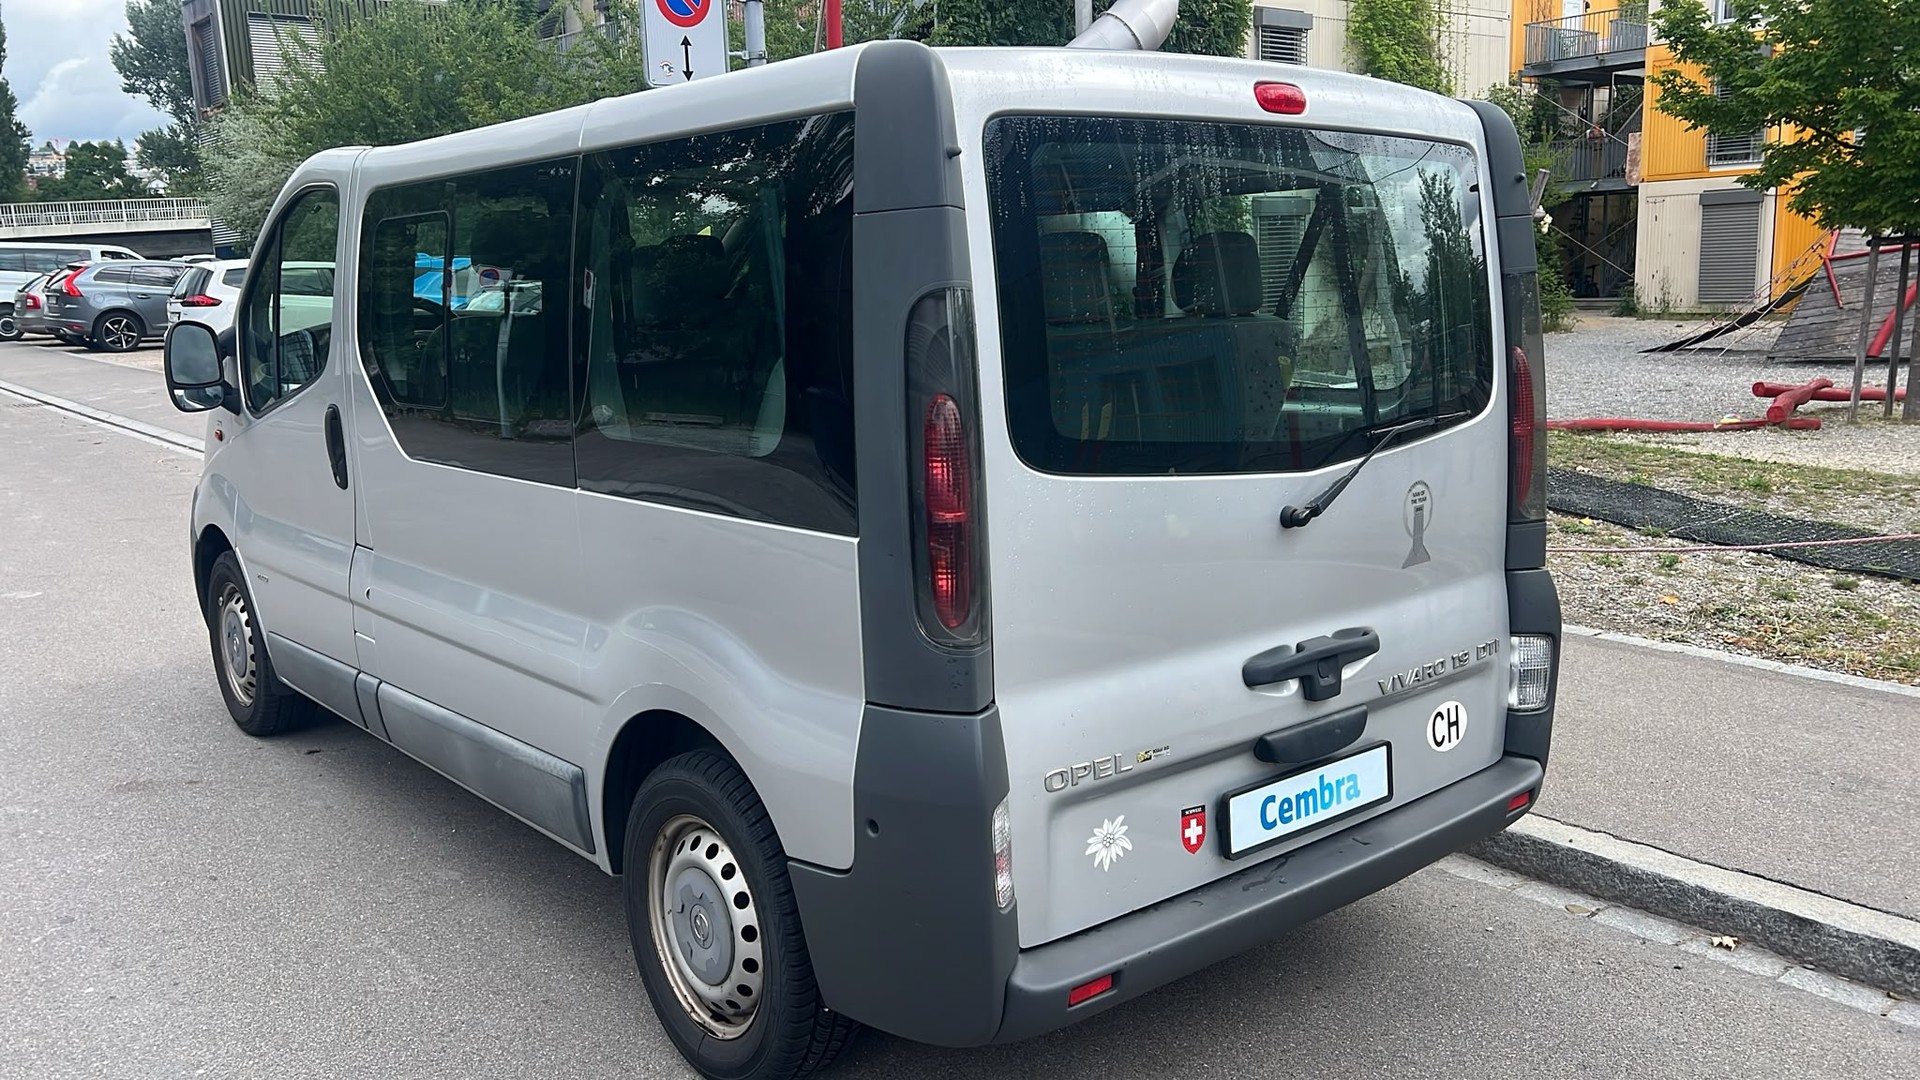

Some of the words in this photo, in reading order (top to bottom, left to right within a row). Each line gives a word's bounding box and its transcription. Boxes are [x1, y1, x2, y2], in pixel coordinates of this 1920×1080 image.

[1378, 658, 1446, 695] VIVARO
[1476, 638, 1499, 661] DTI
[1432, 704, 1459, 748] CH
[1044, 752, 1134, 793] OPEL
[1260, 773, 1361, 831] Cembra
